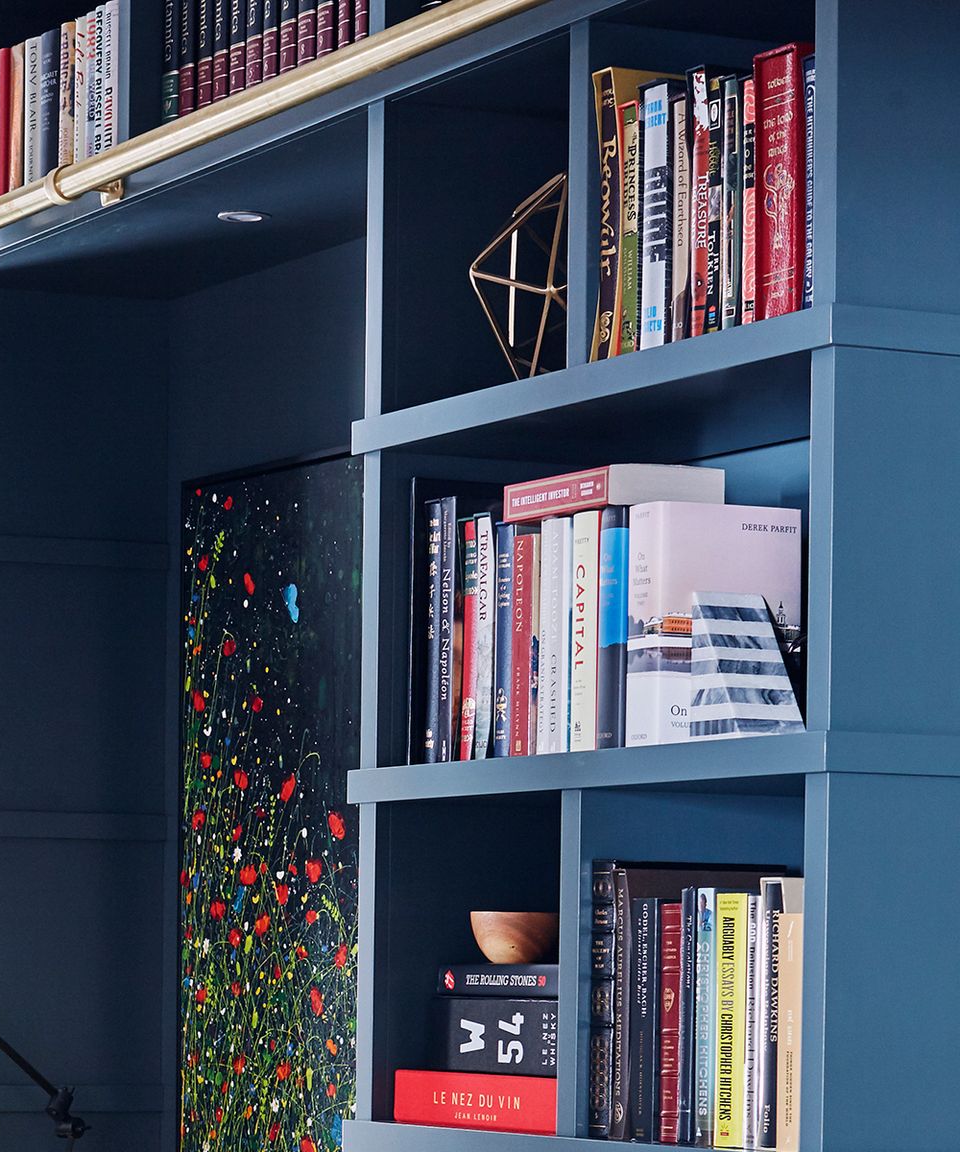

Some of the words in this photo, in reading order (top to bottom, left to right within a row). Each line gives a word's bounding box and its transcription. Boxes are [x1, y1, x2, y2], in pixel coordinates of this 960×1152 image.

[30, 44, 38, 87] TONY
[29, 93, 37, 132] BLAIR
[105, 87, 113, 151] REVOLUTI
[678, 113, 685, 124] A
[678, 129, 688, 176] Wizard
[627, 145, 637, 221] PRINCESS
[678, 178, 688, 189] of
[678, 191, 687, 247] Earthsea
[696, 171, 709, 249] TREASURE
[806, 210, 813, 222] TO
[707, 231, 716, 295] TOLKIEN
[512, 497, 521, 508] THE
[520, 492, 548, 506] INTELLIGENT
[548, 488, 570, 501] INVESTOR
[742, 523, 769, 532] DEREK
[770, 525, 798, 534] PARFIT
[480, 531, 489, 621] TRAFALGAR
[637, 552, 645, 561] On
[442, 569, 452, 614] Nelson
[516, 541, 524, 632] NAPOLEON
[442, 619, 450, 635] &
[575, 565, 586, 670] CAPITAL
[440, 638, 450, 701] Napoléon
[671, 705, 688, 717] On
[722, 916, 735, 961] ARGUABLY
[772, 910, 780, 974] RICHARD
[466, 975, 480, 986] THE
[480, 975, 509, 986] ROLLING
[510, 975, 537, 987] STONES
[538, 975, 547, 987] 50
[701, 942, 710, 1040] CHRISTOPHER
[721, 962, 735, 997] ESSAYS
[721, 1001, 735, 1013] BY
[770, 978, 779, 1042] DAWKINS
[459, 1019, 486, 1054] W
[498, 1012, 525, 1064] 54
[542, 1049, 548, 1065] LE
[720, 1014, 734, 1075] CHRISTOPHER
[433, 1091, 446, 1105] LE
[452, 1093, 473, 1107] NEZ
[479, 1094, 494, 1109] DU
[499, 1096, 521, 1110] VIN
[699, 1046, 708, 1116] HITCHENS
[719, 1077, 733, 1121] HITCHENS
[454, 1112, 471, 1120] JEAN
[474, 1113, 498, 1122] LENOIR
[763, 1105, 771, 1134] Folio
